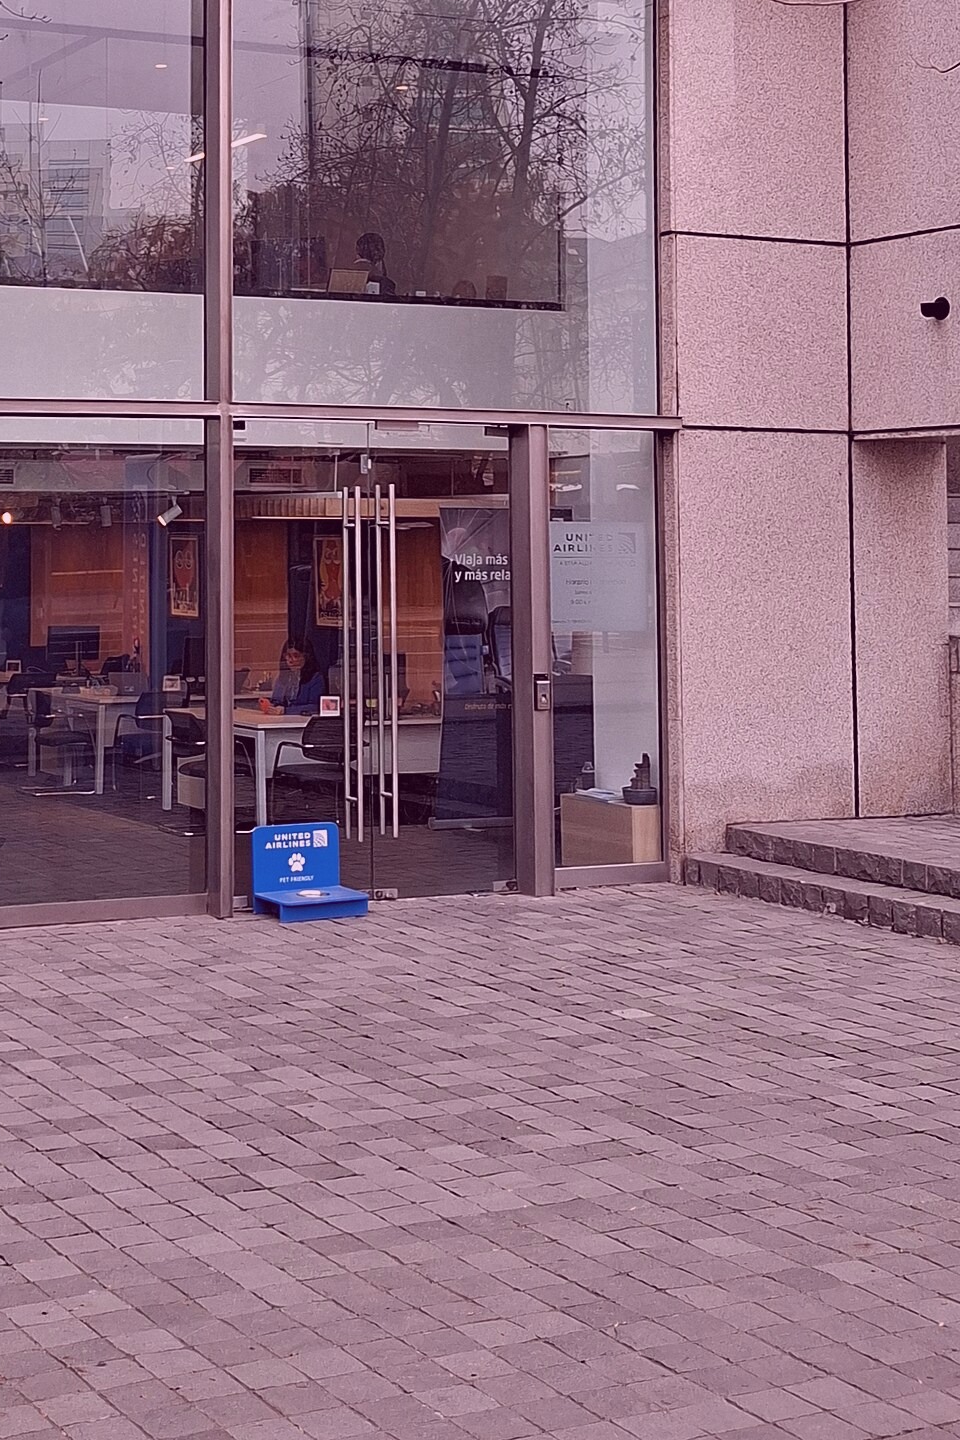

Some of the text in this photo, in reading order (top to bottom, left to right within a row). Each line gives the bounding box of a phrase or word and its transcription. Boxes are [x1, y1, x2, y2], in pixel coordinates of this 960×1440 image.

[454, 553, 508, 567] Viaja más
[455, 570, 462, 583] y
[464, 569, 488, 581] más
[274, 832, 311, 841] UNITED
[265, 840, 311, 849] AIRLINES
